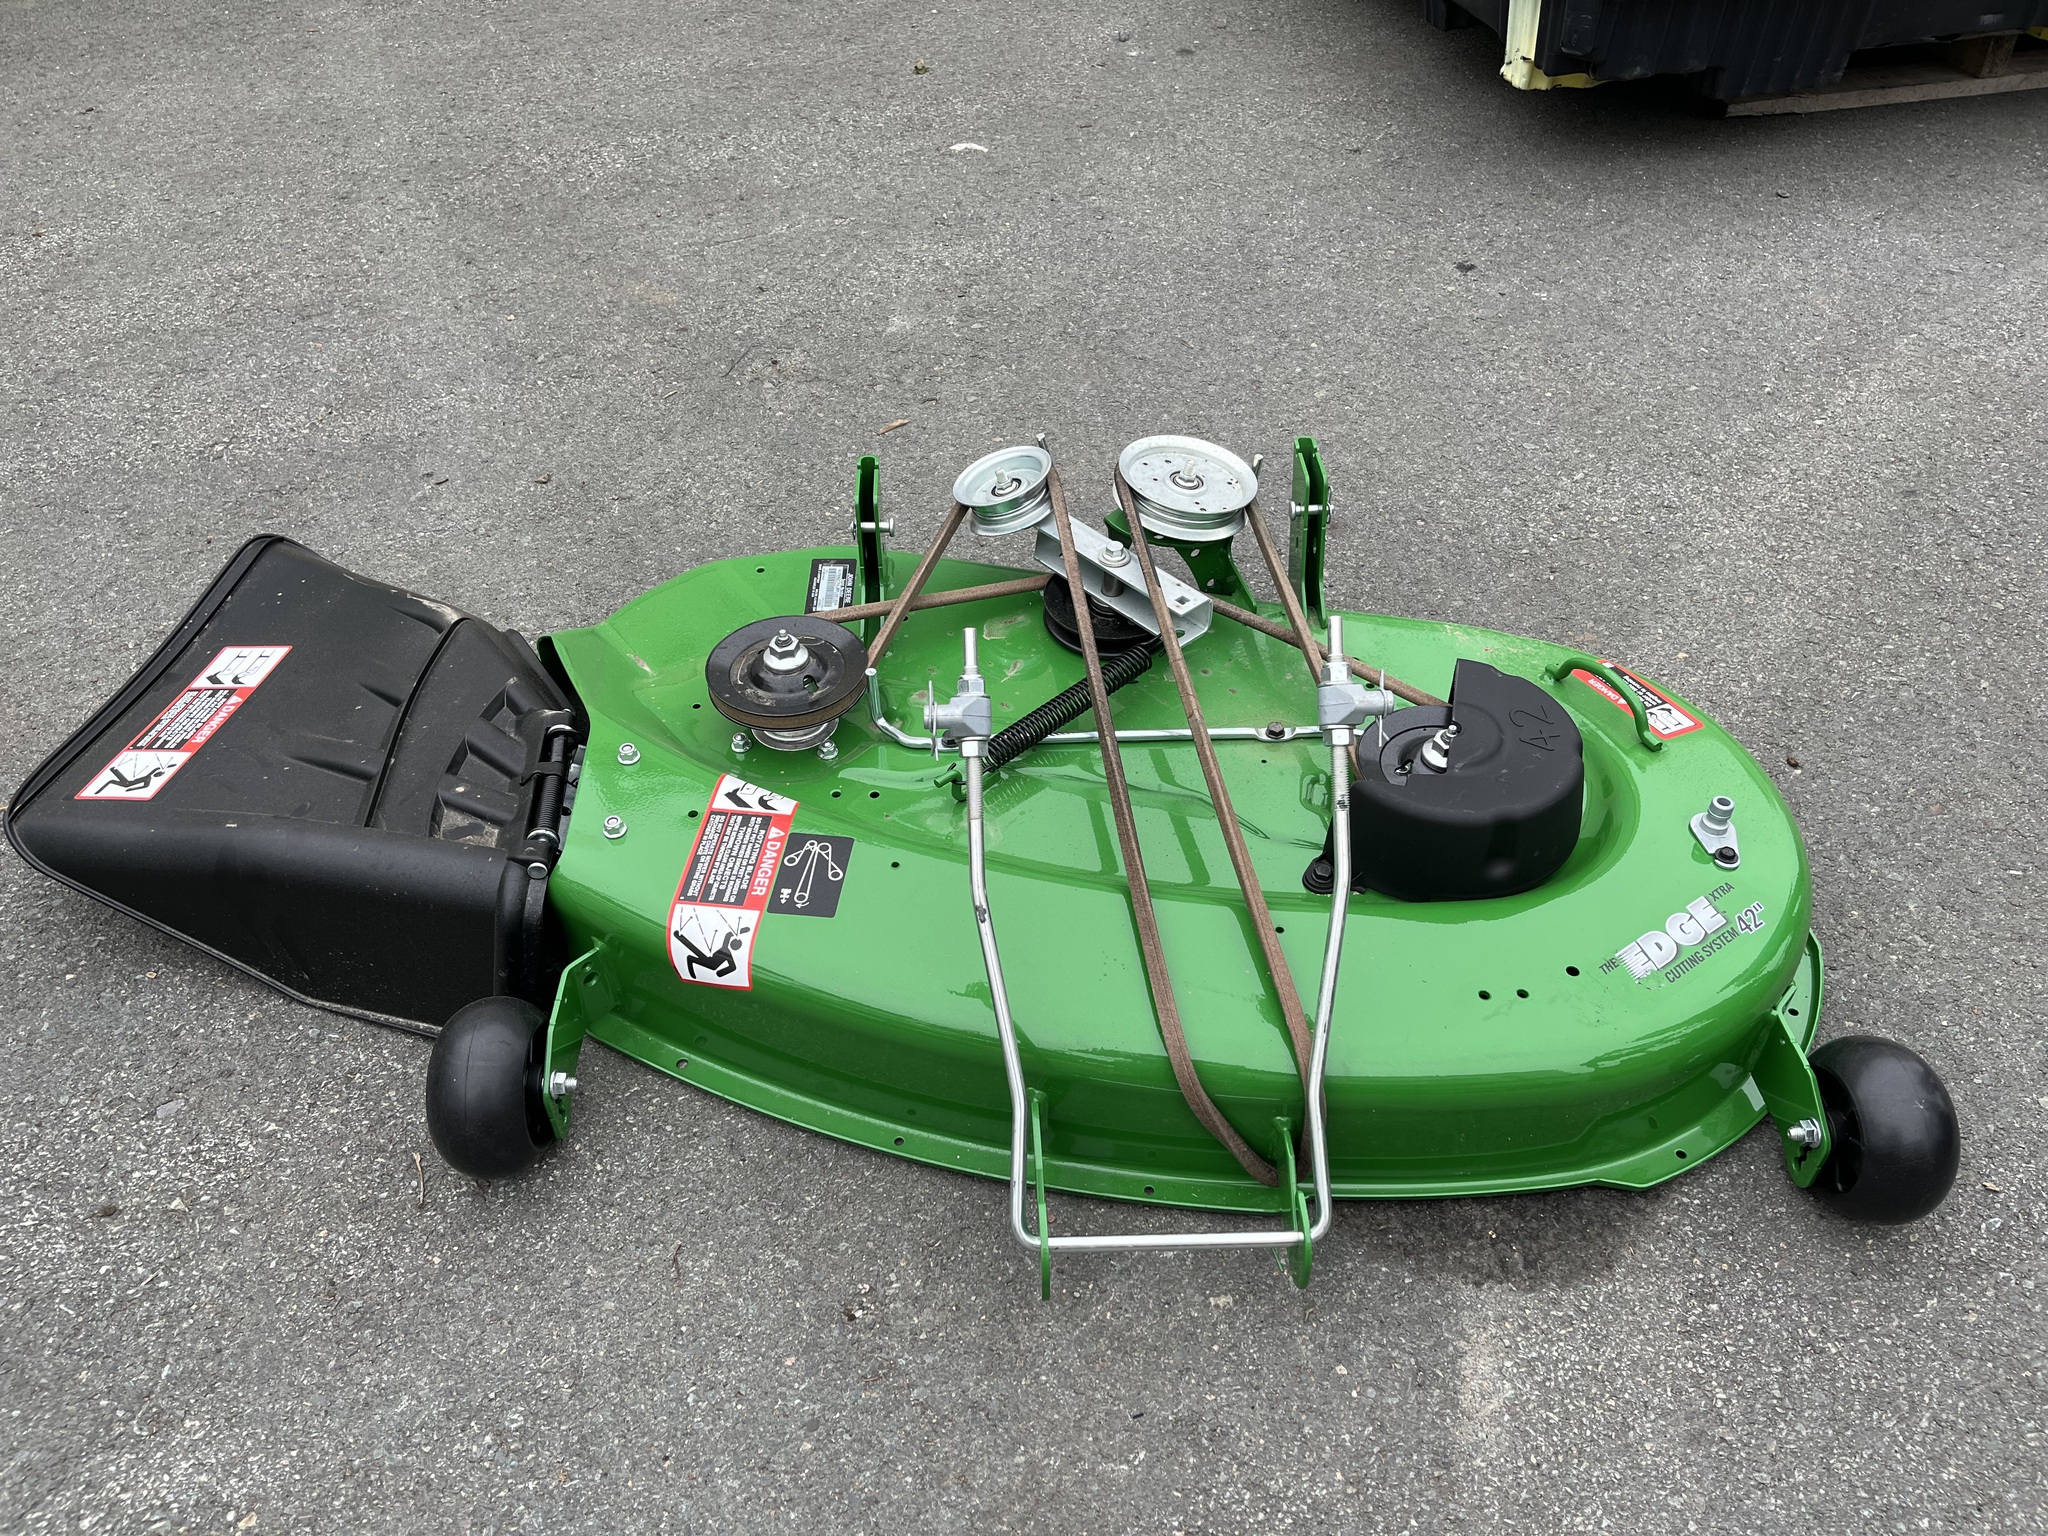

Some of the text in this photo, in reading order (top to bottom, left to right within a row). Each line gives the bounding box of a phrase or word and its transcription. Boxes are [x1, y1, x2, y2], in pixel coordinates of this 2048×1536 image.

[844, 587, 852, 603] DEERE
[1586, 678, 1620, 700] DANGER
[188, 705, 237, 742] DANGER
[718, 825, 746, 890] THROWN OBJECTS
[739, 829, 765, 889] ROTATING BLADE
[750, 840, 781, 896] DANGER
[1708, 882, 1735, 902] XTRA
[1598, 895, 1728, 984] THE EDGE
[1664, 901, 1765, 983] CUTTING SYSTEM 42"
